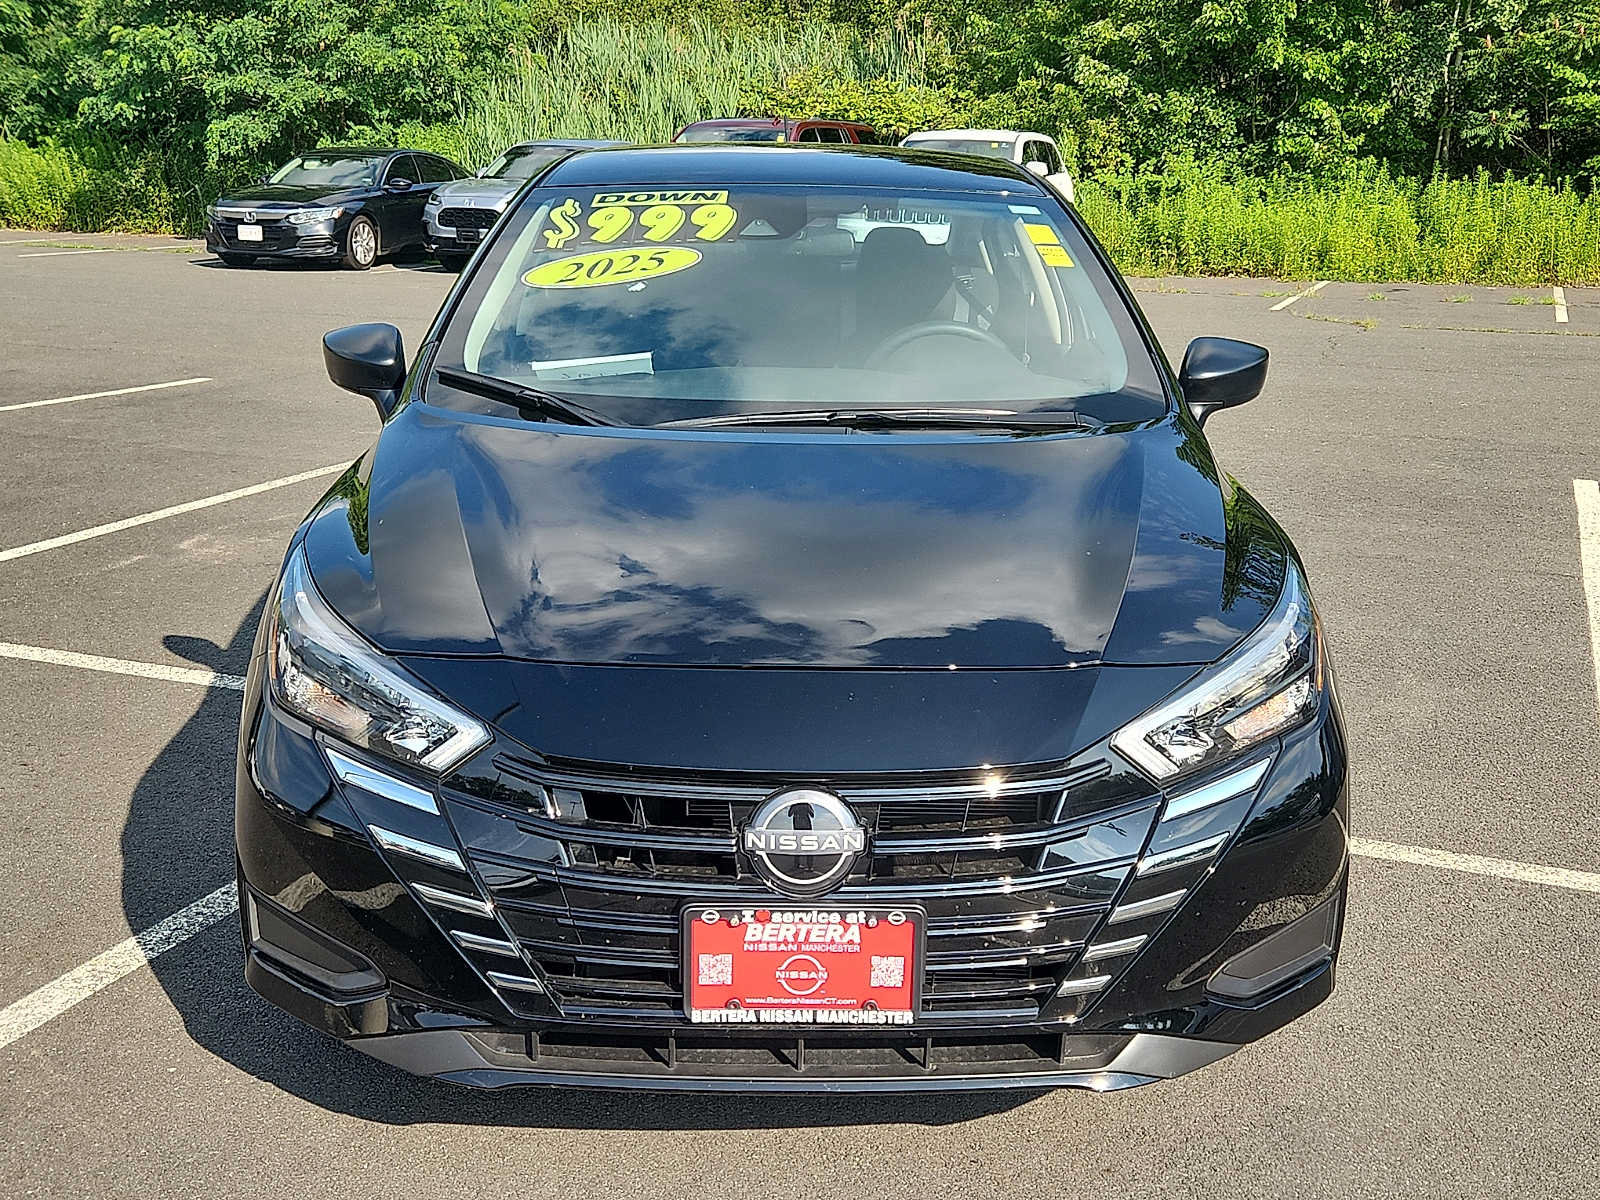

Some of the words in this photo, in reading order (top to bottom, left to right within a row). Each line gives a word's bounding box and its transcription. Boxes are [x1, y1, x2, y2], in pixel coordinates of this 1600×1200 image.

[599, 192, 720, 204] DOWN
[542, 198, 738, 249] $999
[555, 250, 671, 284] 2025
[746, 832, 862, 851] NISSAN
[741, 910, 755, 923] I
[771, 910, 841, 923] service
[845, 910, 866, 924] at
[743, 923, 861, 943] BERTERA
[743, 943, 798, 952] NISSAN
[801, 944, 861, 953] MANCHESTER
[775, 970, 828, 980] NISSAN
[745, 996, 857, 1005] www.BerteraNissanCT.com
[691, 1009, 757, 1023] BERTERA
[759, 1010, 815, 1023] NISSAN
[816, 1010, 914, 1025] MANCHESTER
